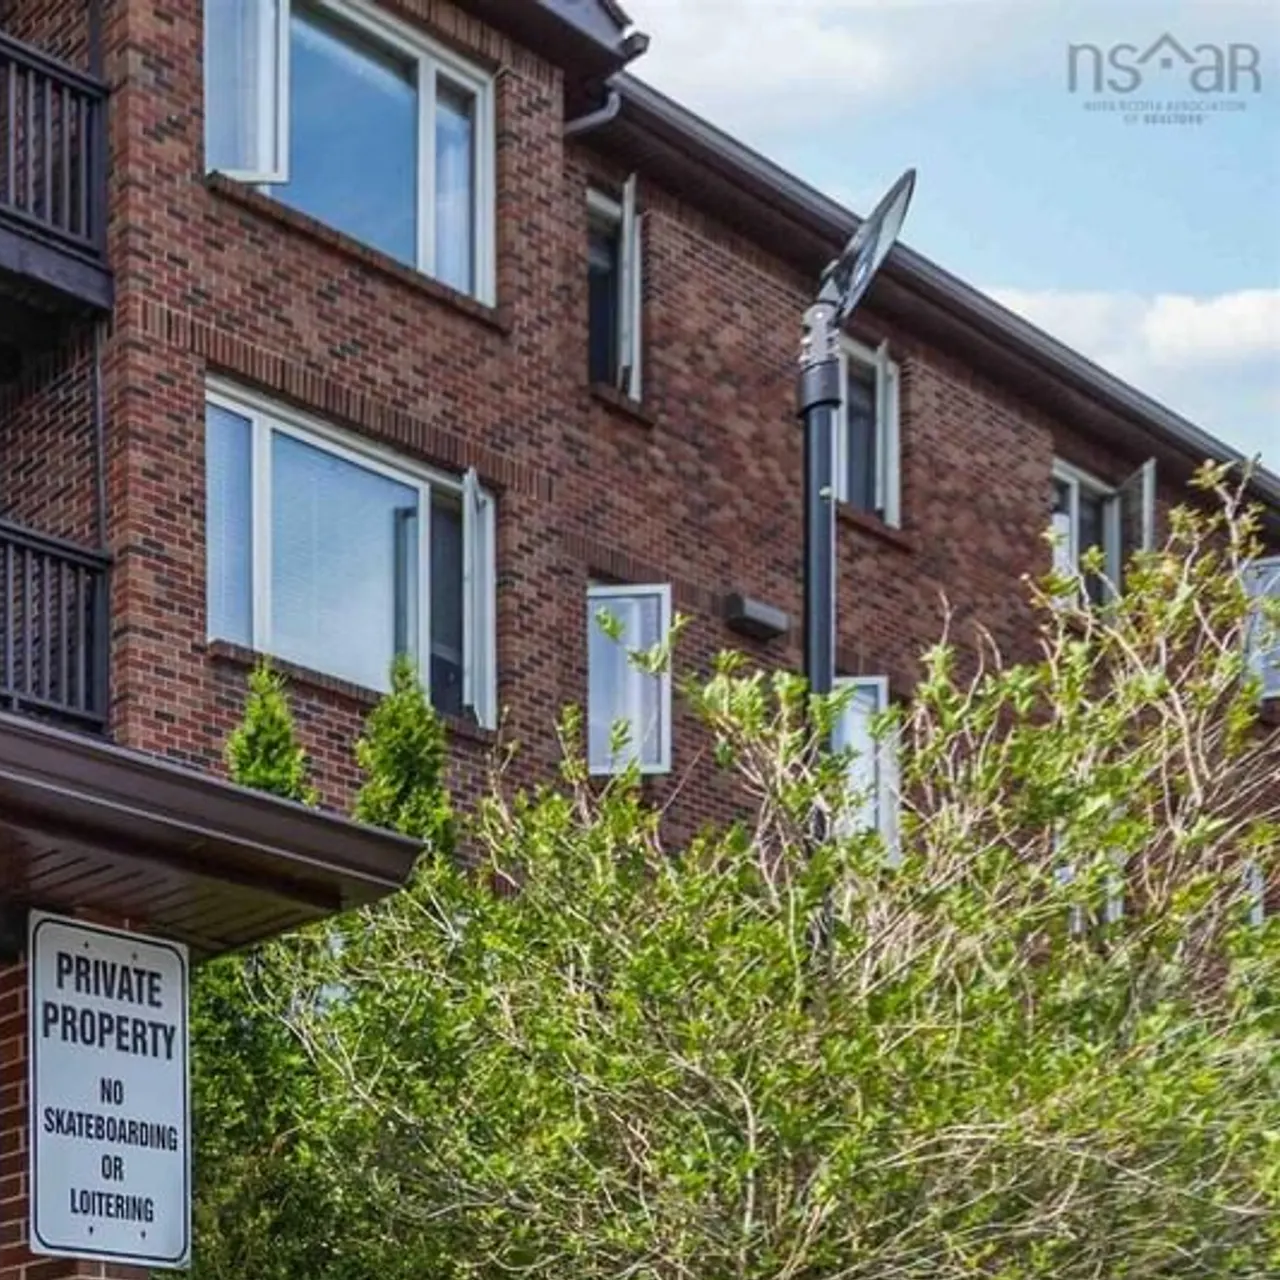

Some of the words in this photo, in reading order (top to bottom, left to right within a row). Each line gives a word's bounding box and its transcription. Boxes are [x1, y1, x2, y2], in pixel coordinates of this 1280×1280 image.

[56, 952, 162, 1008] PRIVATE
[42, 1000, 176, 1060] PROPERTY
[100, 1077, 124, 1105] NO
[44, 1107, 178, 1151] SKATEBOARDING
[101, 1154, 124, 1181] OR
[70, 1188, 154, 1223] LOITERING
